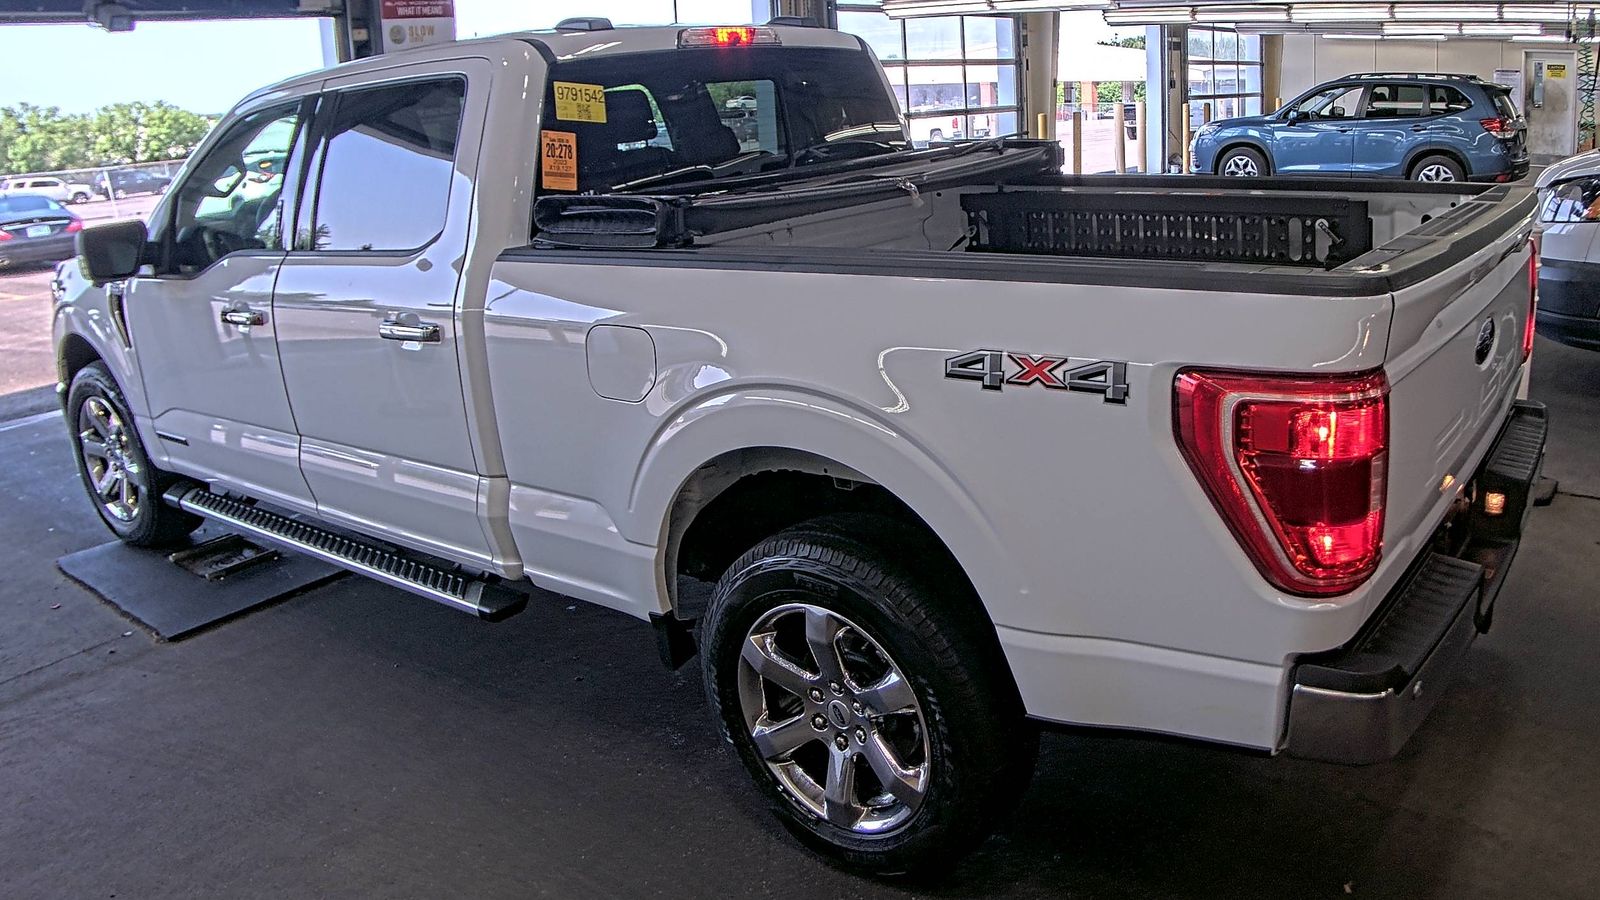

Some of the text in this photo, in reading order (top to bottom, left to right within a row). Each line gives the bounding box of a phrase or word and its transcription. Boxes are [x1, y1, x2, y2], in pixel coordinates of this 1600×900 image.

[396, 6, 414, 15] WHAT
[415, 6, 421, 15] IT
[408, 25, 435, 37] SLOW
[556, 86, 605, 103] 9791542
[945, 349, 1130, 405] 4X4
